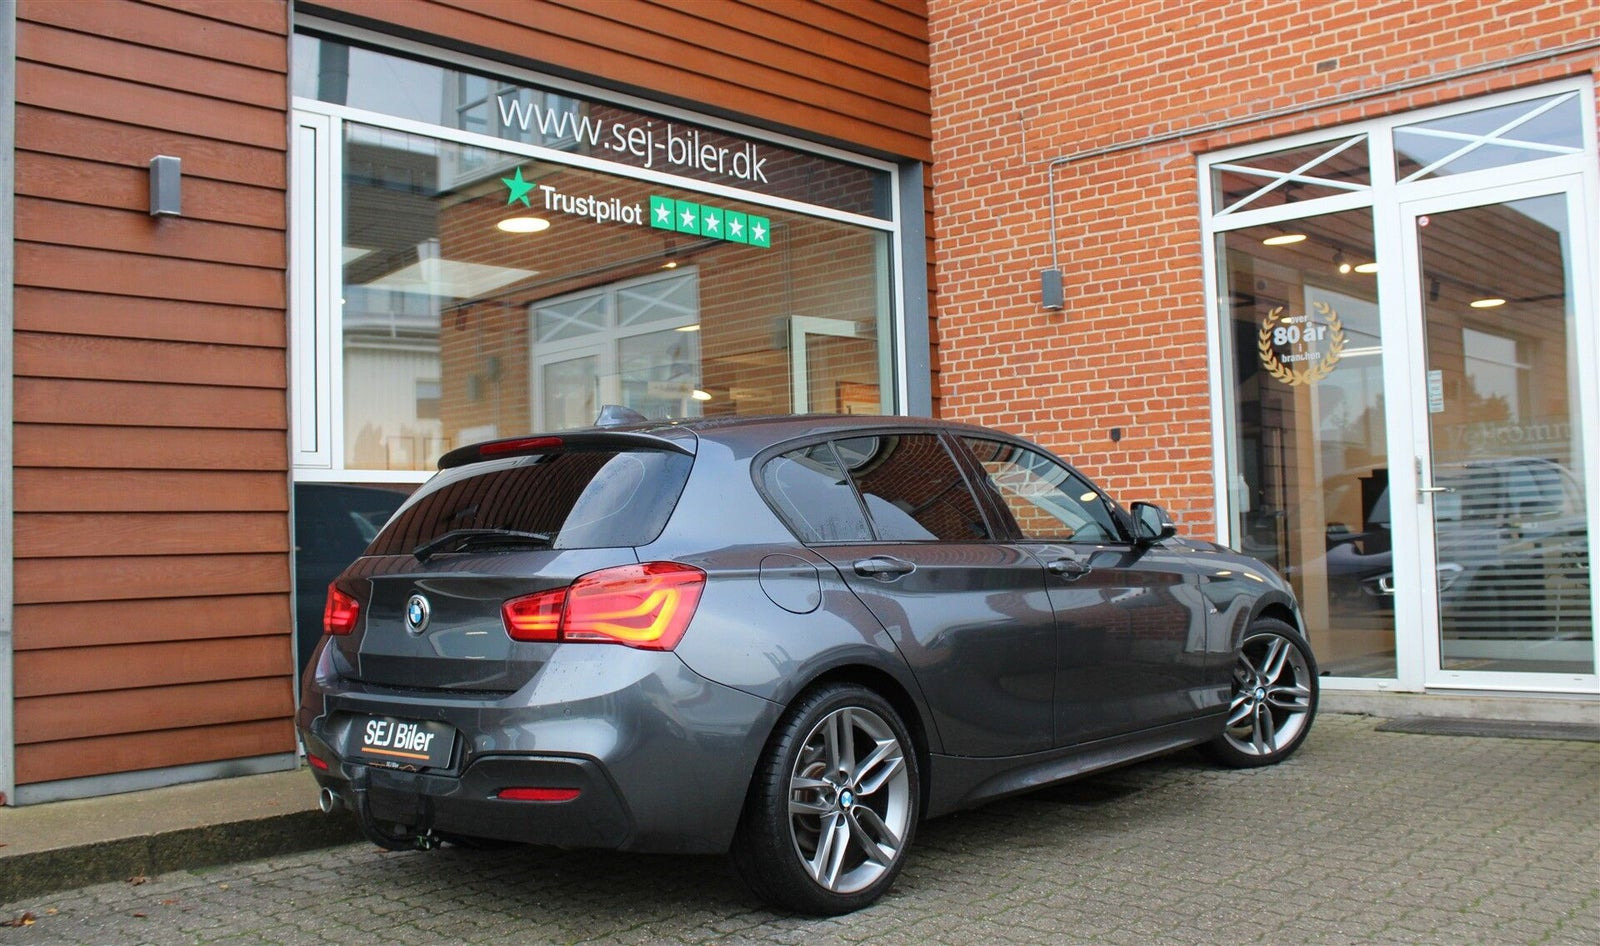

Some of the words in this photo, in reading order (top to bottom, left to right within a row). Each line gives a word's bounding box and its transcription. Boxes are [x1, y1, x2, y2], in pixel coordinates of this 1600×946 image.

[498, 95, 769, 184] www.sej-biler.dk
[539, 184, 643, 225] Trustpilot
[1290, 316, 1307, 324] over
[1274, 325, 1300, 345] 80
[1303, 322, 1326, 342] år
[1281, 352, 1321, 363] branchen
[1299, 343, 1302, 352] i
[364, 720, 394, 746] SEJ
[394, 723, 434, 751] Biler
